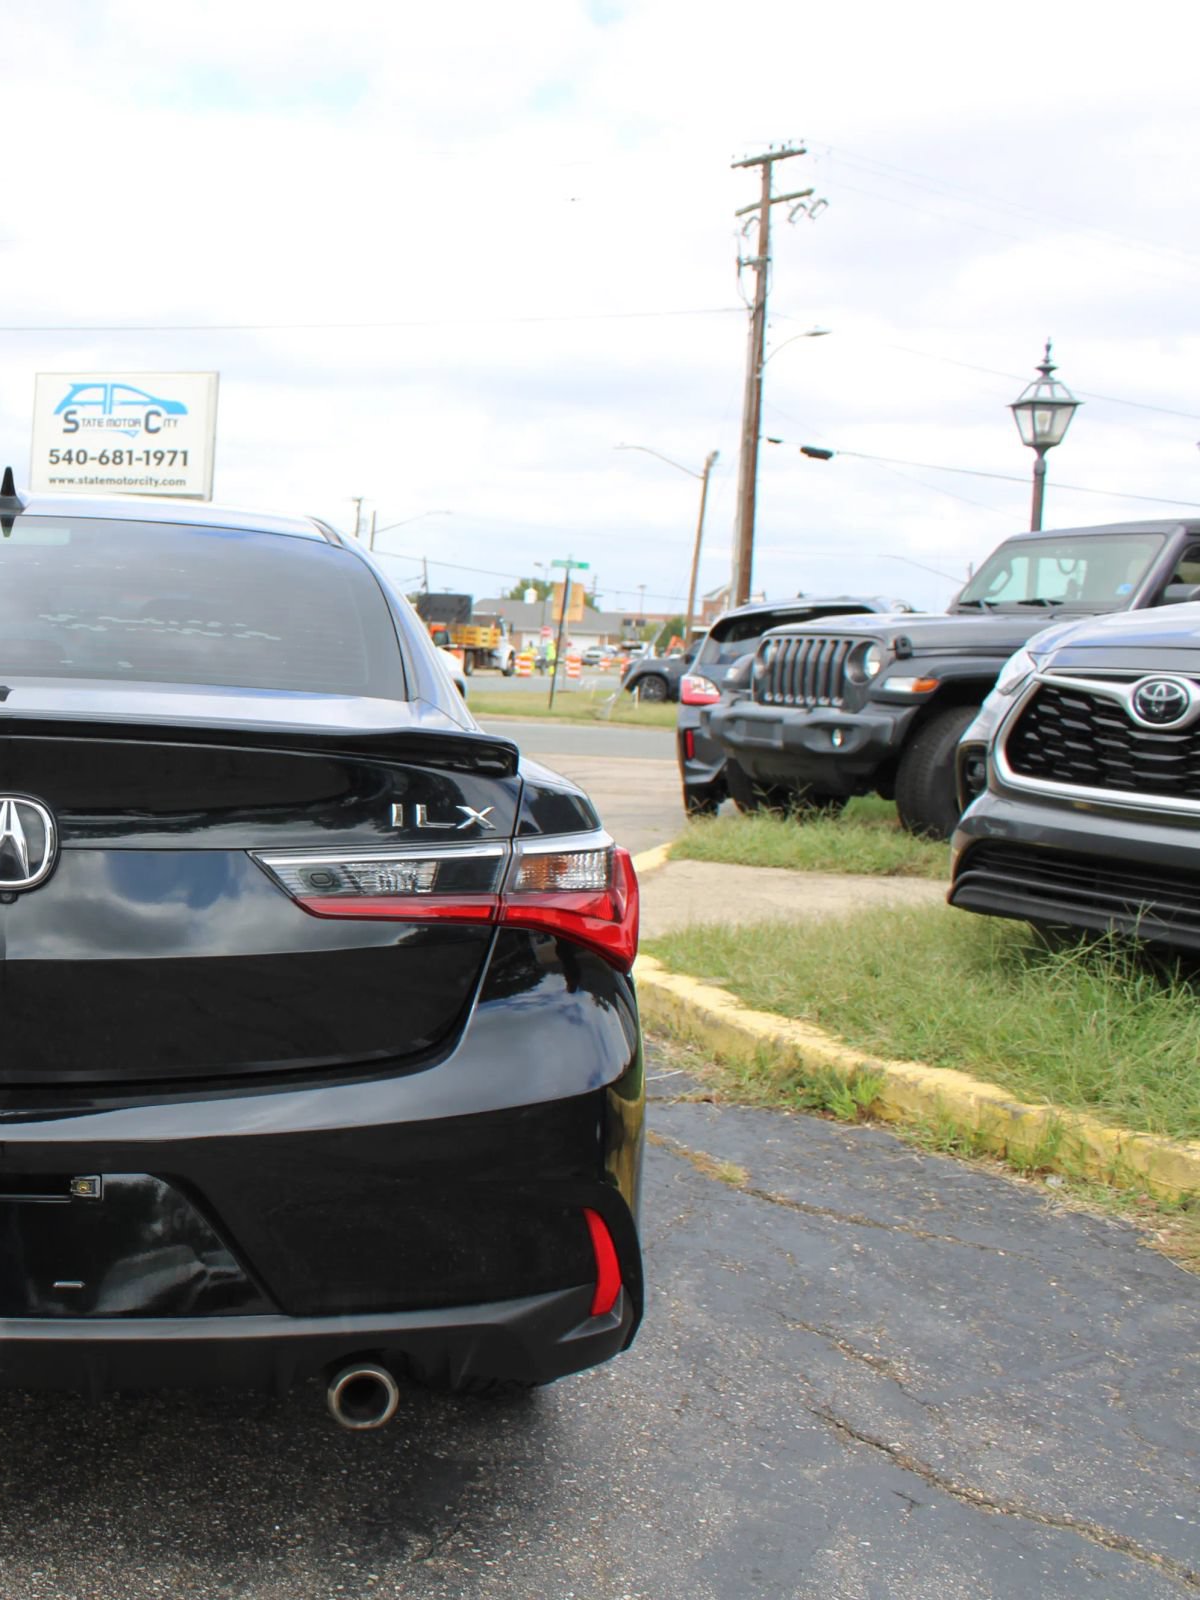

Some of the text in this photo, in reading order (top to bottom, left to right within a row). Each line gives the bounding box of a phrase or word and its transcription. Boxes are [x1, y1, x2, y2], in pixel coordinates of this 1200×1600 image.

[62, 410, 179, 434] STATE MOTOR CITY
[48, 449, 188, 466] 540-681-1971
[48, 475, 187, 487] www.statemotorcity.com
[391, 803, 497, 831] ILX
